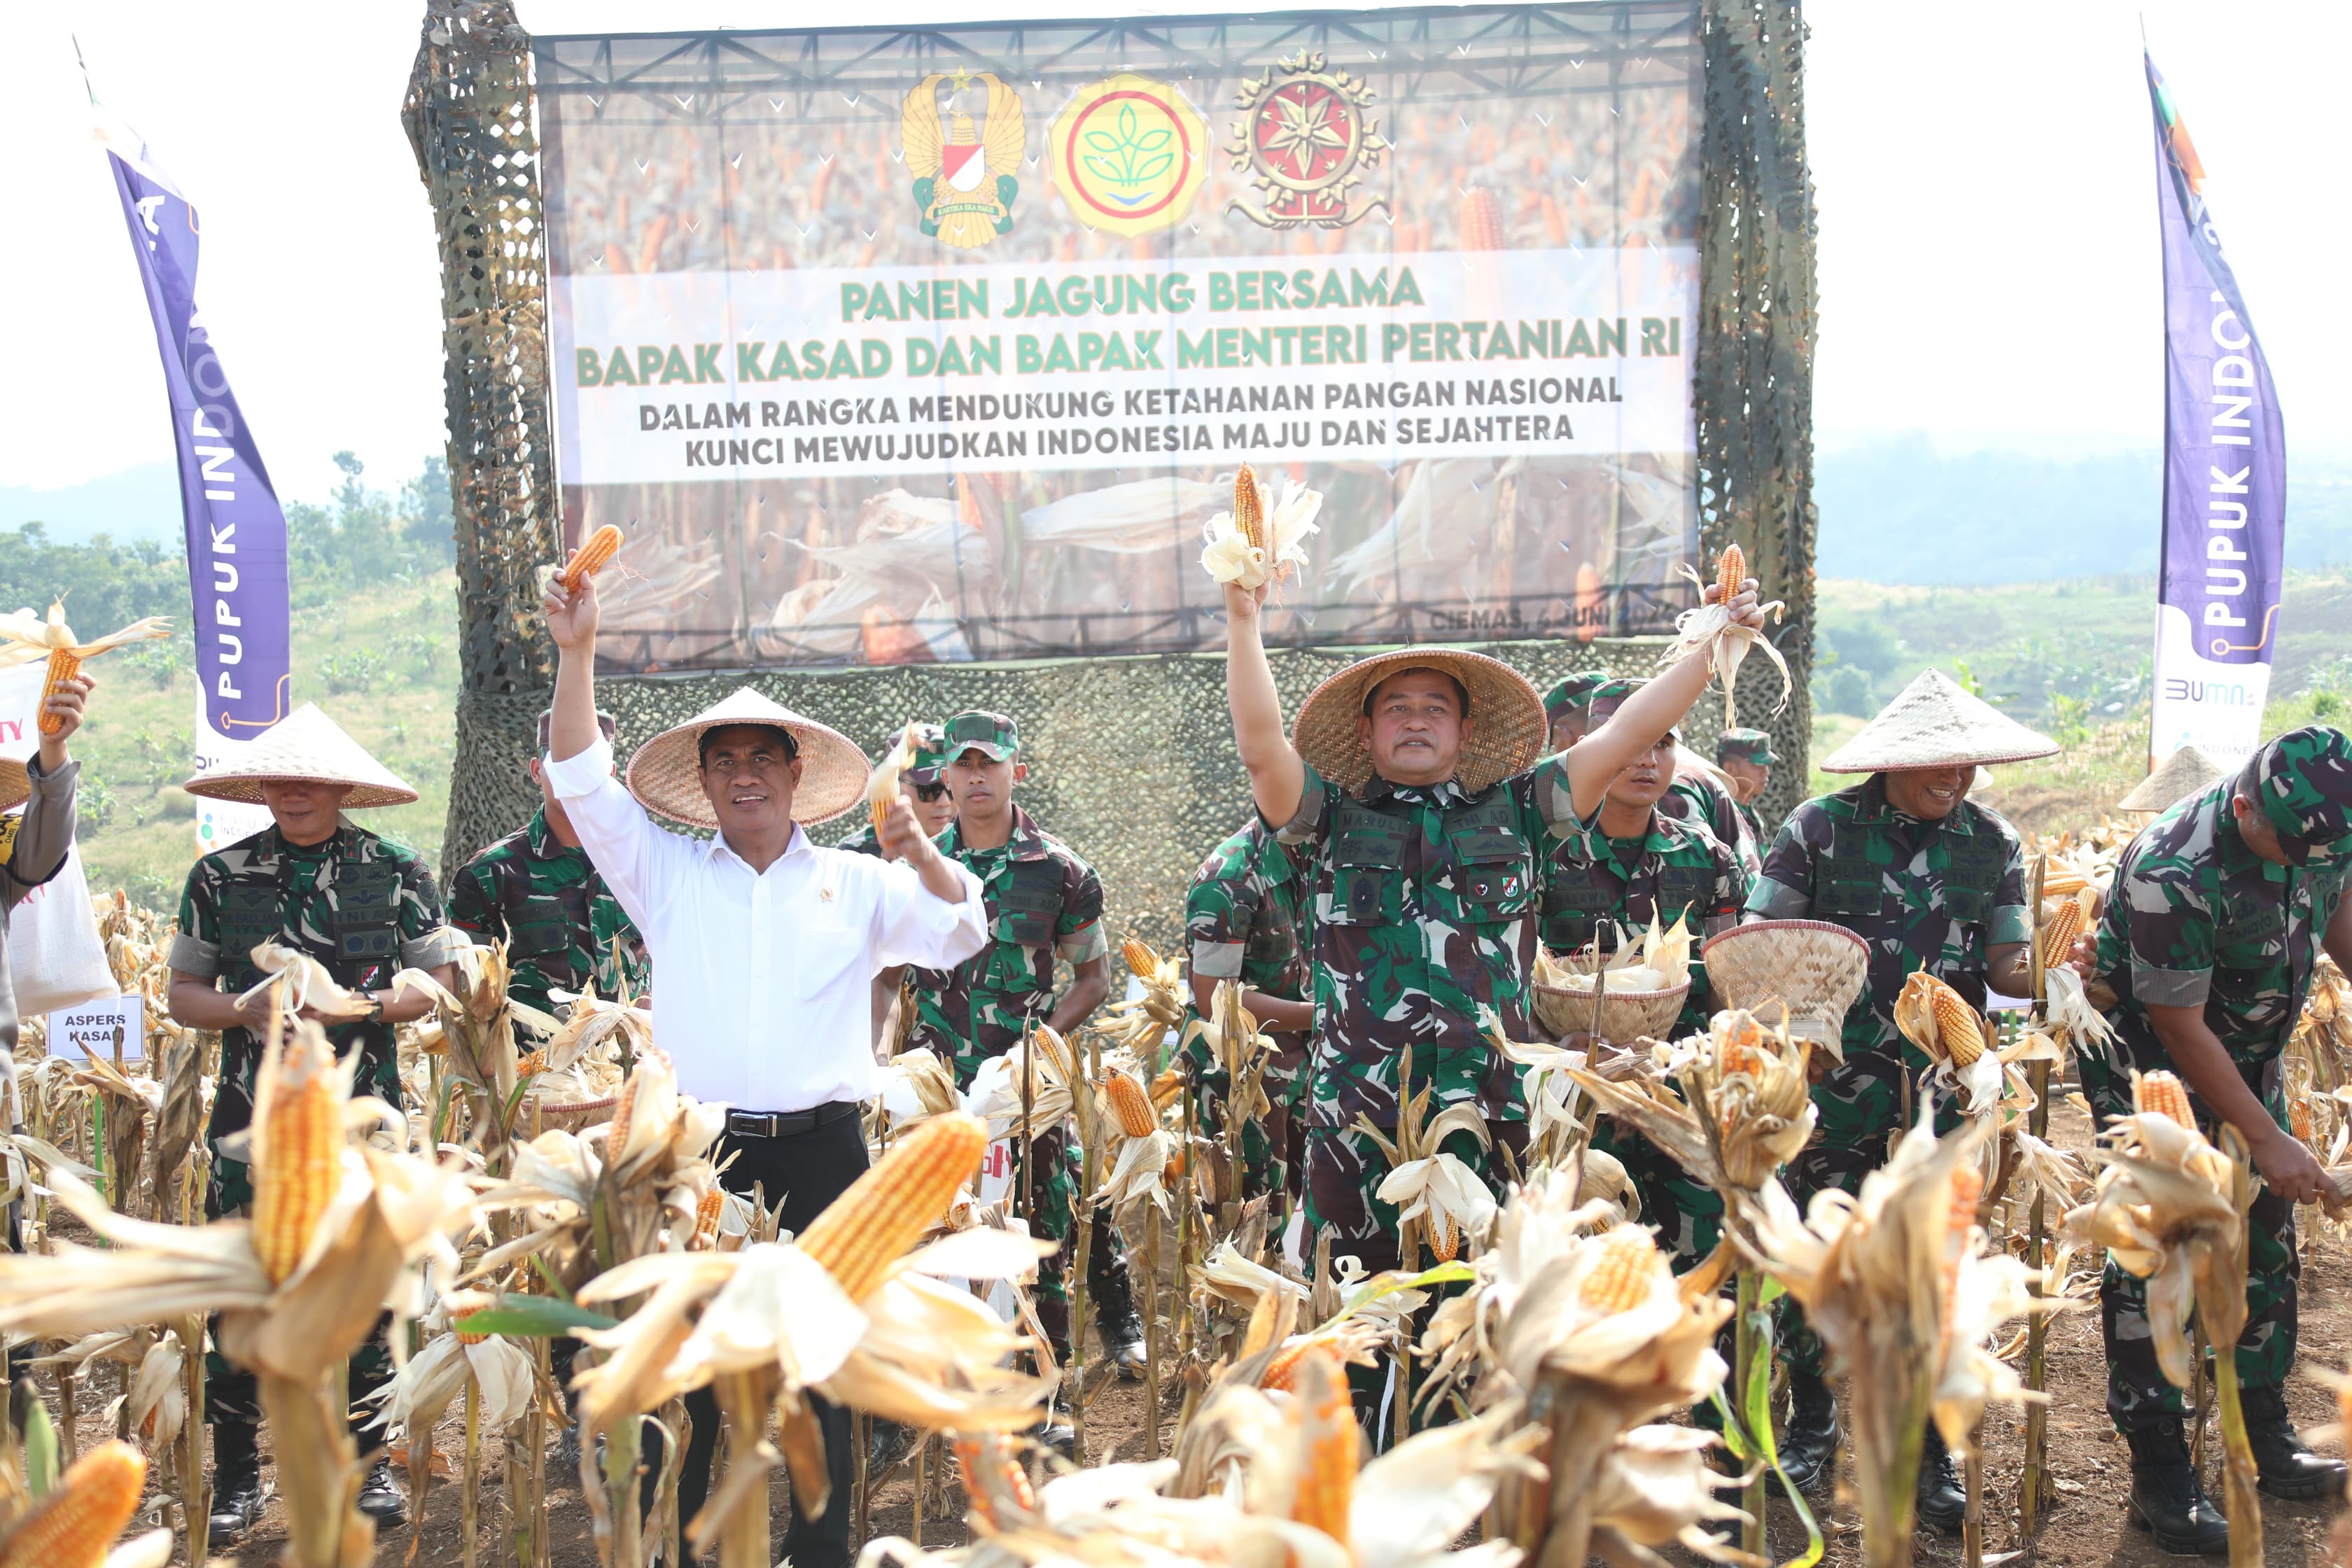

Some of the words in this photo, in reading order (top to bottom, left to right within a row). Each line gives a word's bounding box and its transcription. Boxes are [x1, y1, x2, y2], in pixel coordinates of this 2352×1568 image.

[841, 277, 989, 323] PANEN
[1002, 272, 1196, 318] JAGUNG
[1208, 266, 1425, 312] BERSAMA
[575, 342, 725, 388] BAPAK
[737, 339, 893, 384] KASAD
[906, 334, 1002, 378] DAN
[1016, 329, 1165, 374] BAPAK
[1177, 323, 1367, 370] MENTERI
[1382, 317, 1628, 363] PERTANIAN
[1641, 316, 1681, 357] RI
[640, 401, 750, 431] DALAM
[762, 397, 900, 426] RANGKA
[910, 391, 1114, 421] MENDUKUNG
[1125, 384, 1314, 415] KETAHANAN
[1325, 380, 1455, 410] PANGAN
[1466, 377, 1623, 405] NASIONAL
[686, 438, 784, 467] KUNCI
[794, 430, 1028, 463] MEWUJUDKAN
[1037, 424, 1214, 455] INDONESIA
[1223, 421, 1310, 449] MAJU
[1321, 420, 1386, 447] DAN
[1396, 414, 1574, 445] SEJAHTERA
[2204, 465, 2250, 626] PUPUK
[211, 522, 242, 700] PUPUK
[1431, 608, 1528, 632] CIEMAS,
[1559, 604, 1611, 627] JUNI
[65, 1014, 126, 1026] ASPERS
[69, 1030, 124, 1042] KASA
